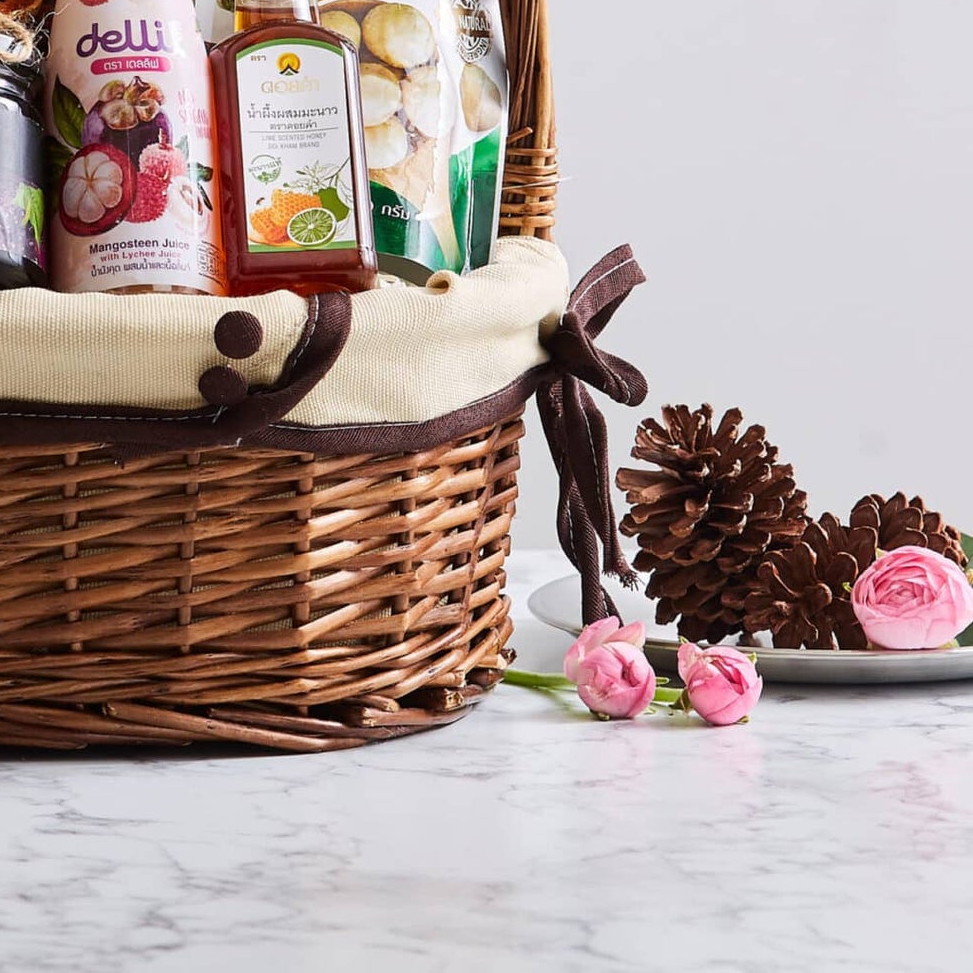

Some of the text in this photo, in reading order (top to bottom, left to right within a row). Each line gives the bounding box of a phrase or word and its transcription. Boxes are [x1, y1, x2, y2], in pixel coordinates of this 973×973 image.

[103, 60, 123, 71] ตรา
[278, 133, 305, 141] SCENTED
[306, 132, 327, 140] HONEY
[380, 204, 411, 221] กรัม
[88, 237, 190, 255] Mangosteen Juice
[100, 252, 119, 263] with
[122, 250, 156, 260] Lychee
